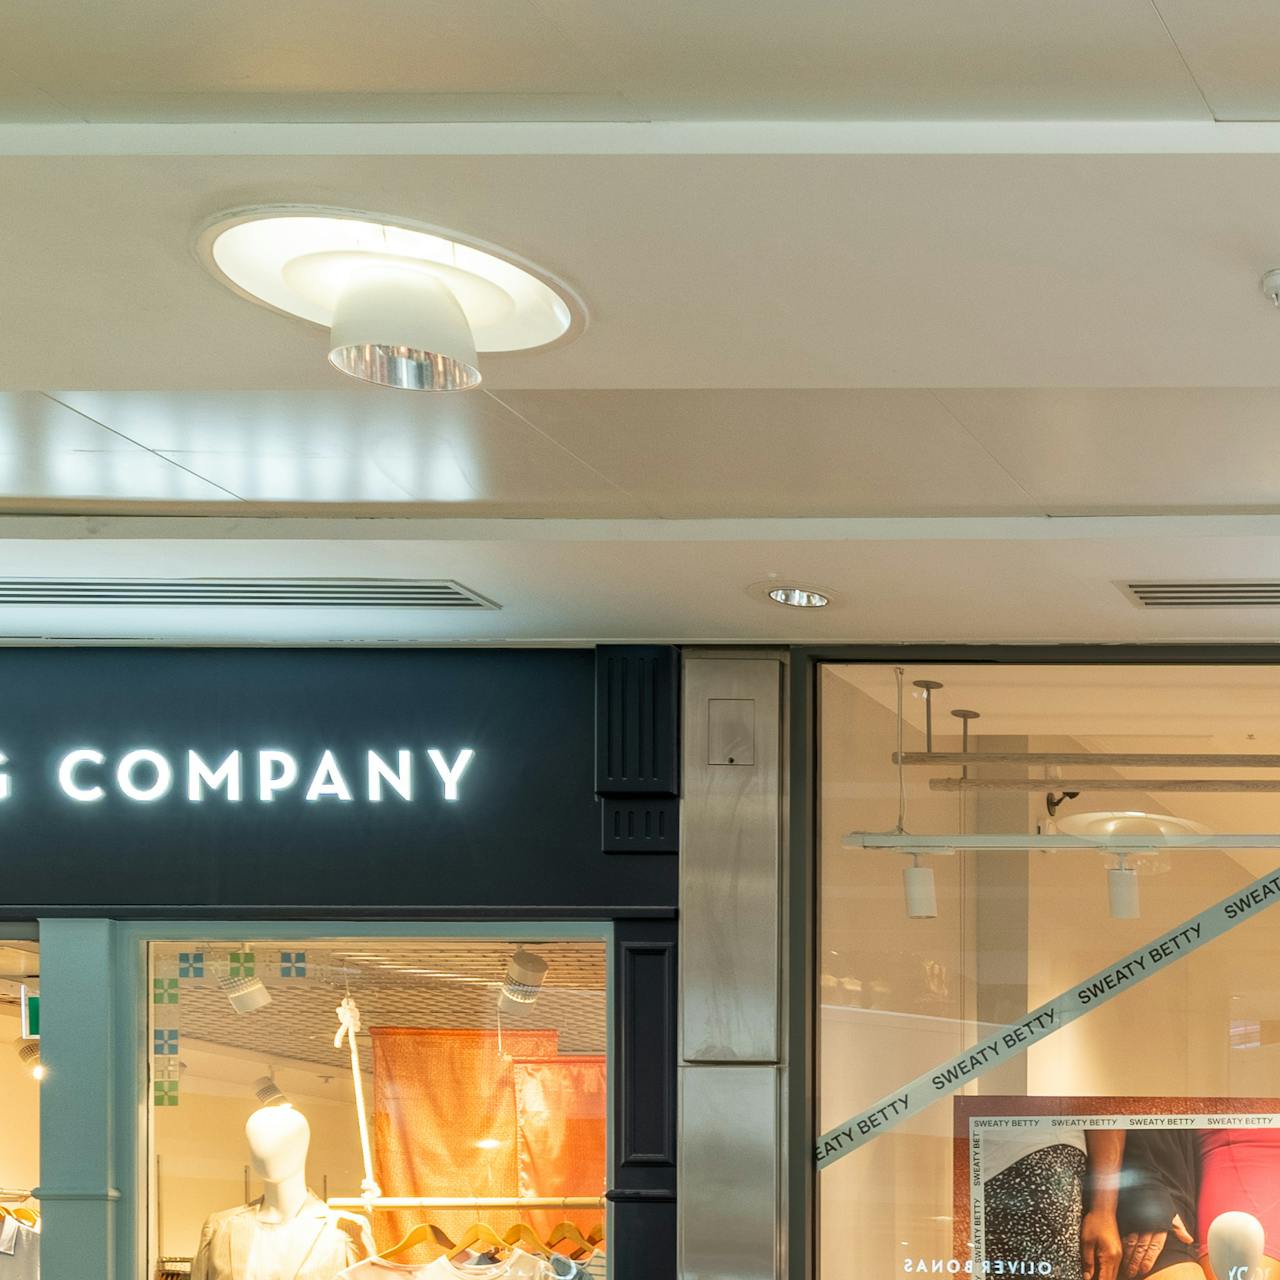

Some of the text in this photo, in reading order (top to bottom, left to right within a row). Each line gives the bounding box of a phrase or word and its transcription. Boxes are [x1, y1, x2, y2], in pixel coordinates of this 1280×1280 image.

[58, 748, 476, 801] COMPANY
[815, 1127, 854, 1161] EATY
[856, 1093, 908, 1136] BETTY
[931, 1040, 1000, 1090] SWEATY
[1002, 1007, 1054, 1049] BETTY
[1078, 955, 1146, 1005] SWEATY
[1148, 922, 1201, 964] BETTY
[973, 1131, 981, 1148] BET
[974, 1119, 1010, 1128] SWEATY
[1011, 1119, 1040, 1127] BETTY
[1051, 1119, 1088, 1127] SWEATY
[1089, 1119, 1117, 1127] BETTY
[1129, 1118, 1165, 1126] SWEATY
[1167, 1118, 1196, 1126] BETTY
[1207, 1117, 1243, 1126] SWEATY
[1245, 1117, 1273, 1125] BETTY
[974, 1227, 982, 1263] SWEATY
